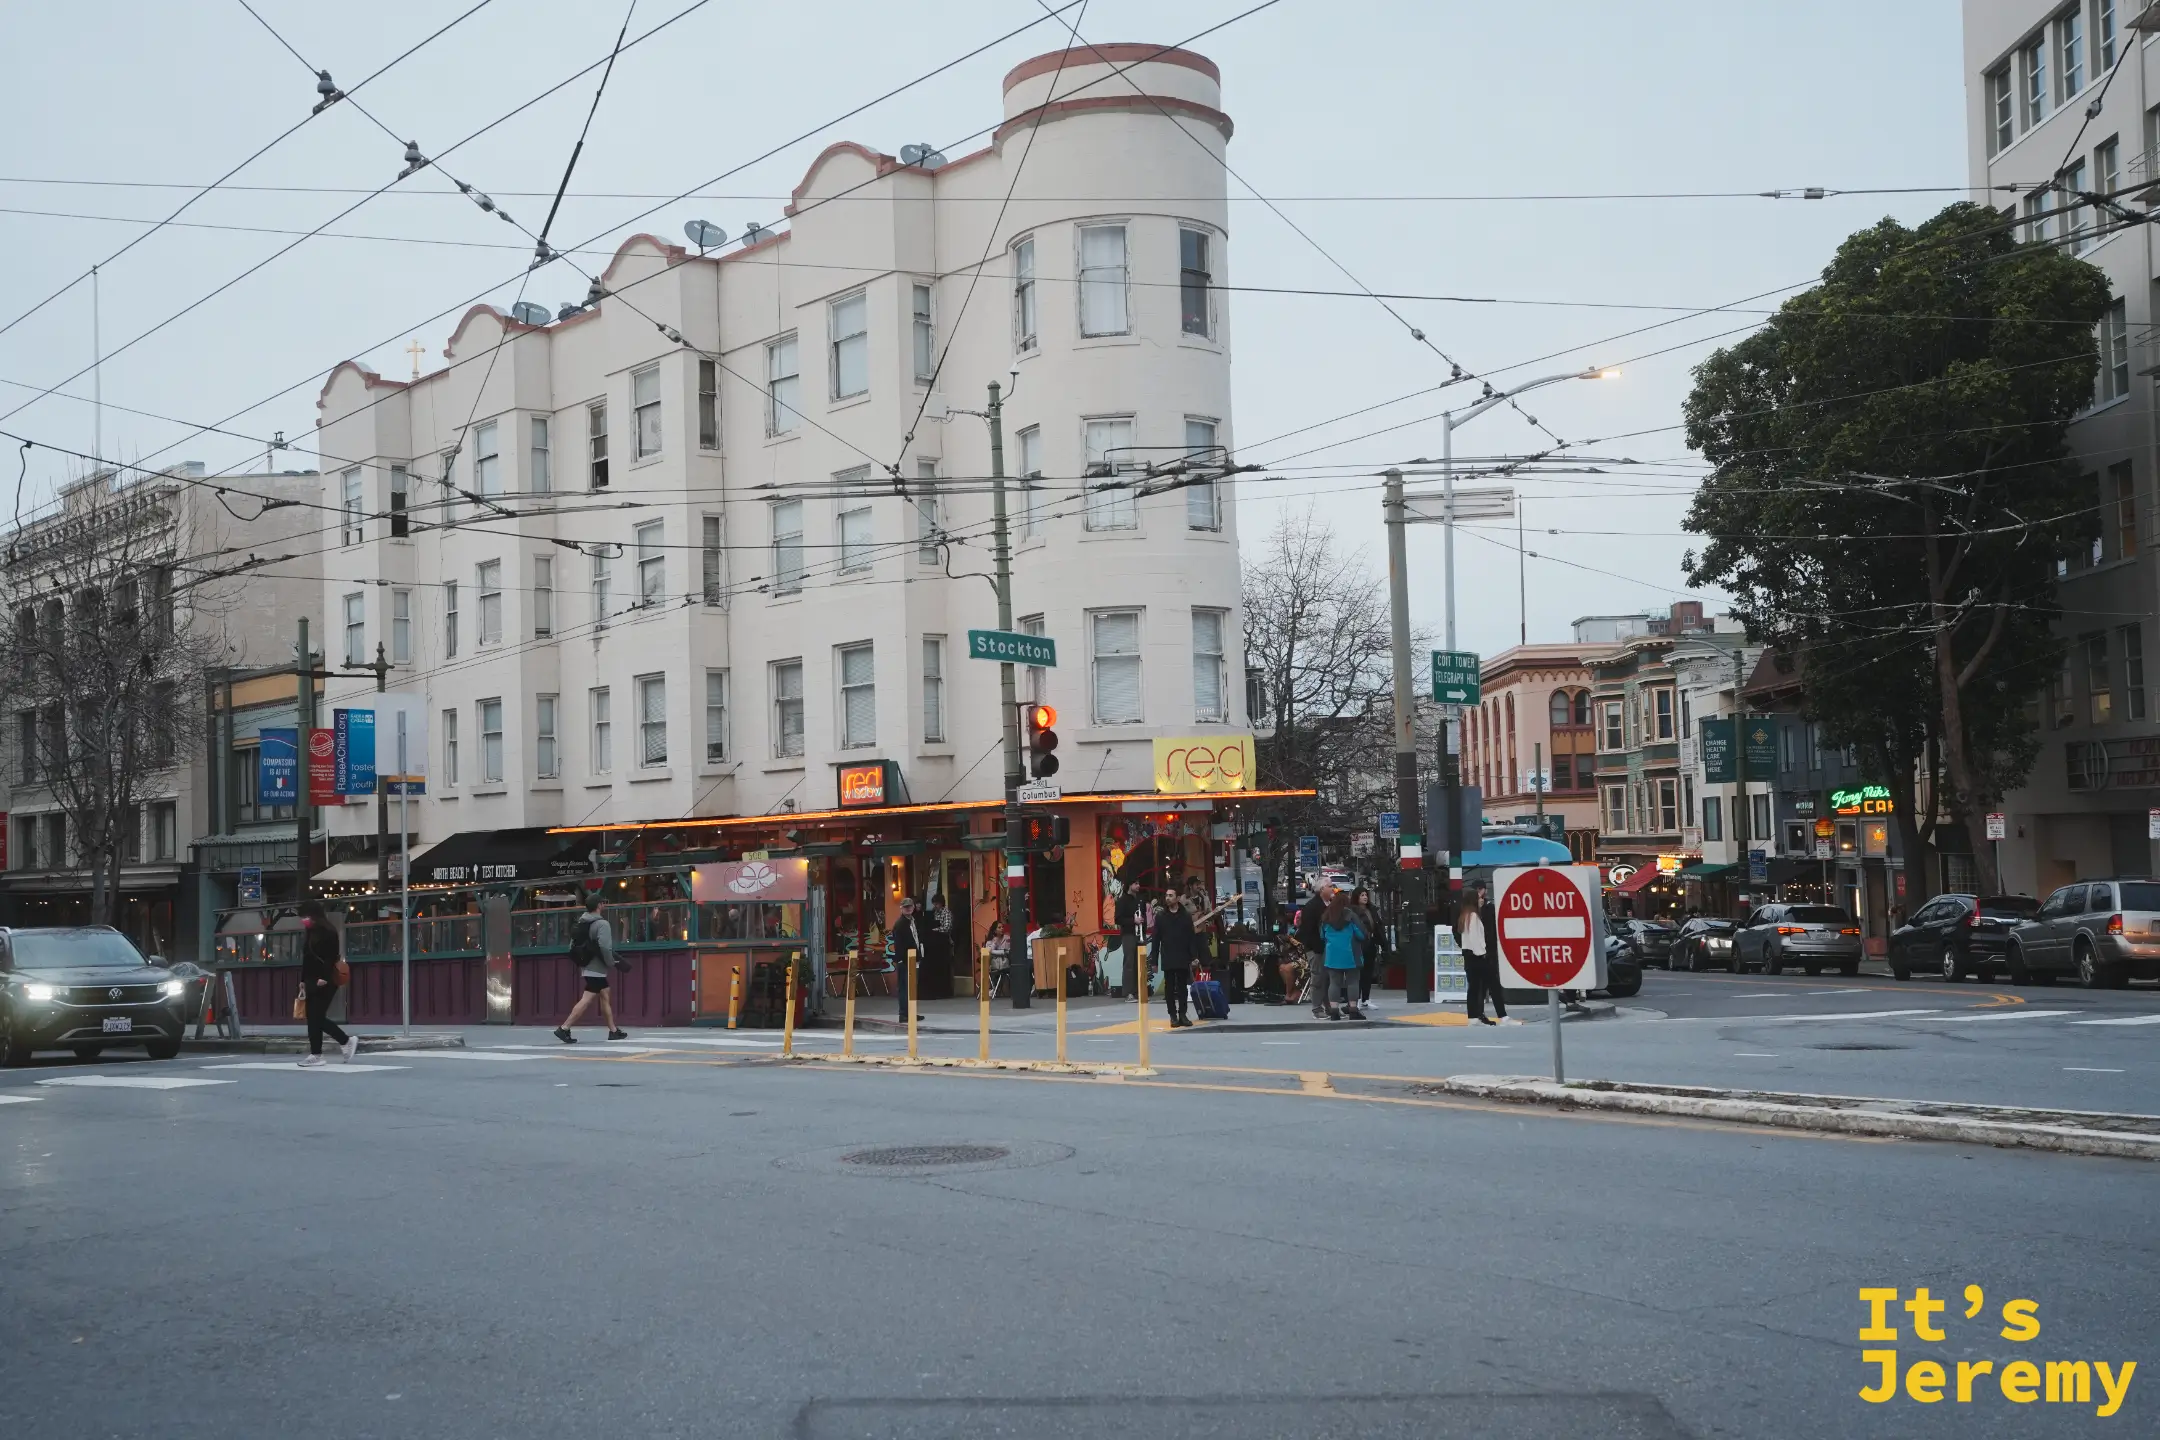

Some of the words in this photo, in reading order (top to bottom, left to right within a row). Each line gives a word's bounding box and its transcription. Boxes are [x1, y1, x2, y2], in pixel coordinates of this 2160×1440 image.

[976, 636, 1050, 660] Stockton
[1437, 655, 1451, 667] COIT
[1455, 656, 1475, 668] TOWER
[1435, 671, 1464, 684] TELEGRAPH
[1467, 673, 1478, 685] HILL
[337, 713, 348, 790] RaiseAChild.org
[1167, 740, 1244, 778] red
[263, 758, 296, 766] COMPASSION
[846, 768, 880, 792] red
[842, 786, 883, 799] window
[1022, 791, 1056, 800] Columbus
[1832, 791, 1862, 808] Tony
[433, 867, 448, 880] NORTH
[449, 866, 464, 879] BEACH
[482, 866, 494, 878] TEST
[495, 864, 516, 878] KITCHEN
[724, 861, 778, 888] red
[1510, 893, 1532, 910] DO
[1544, 892, 1575, 910] NOT
[1520, 945, 1572, 964] ENTER
